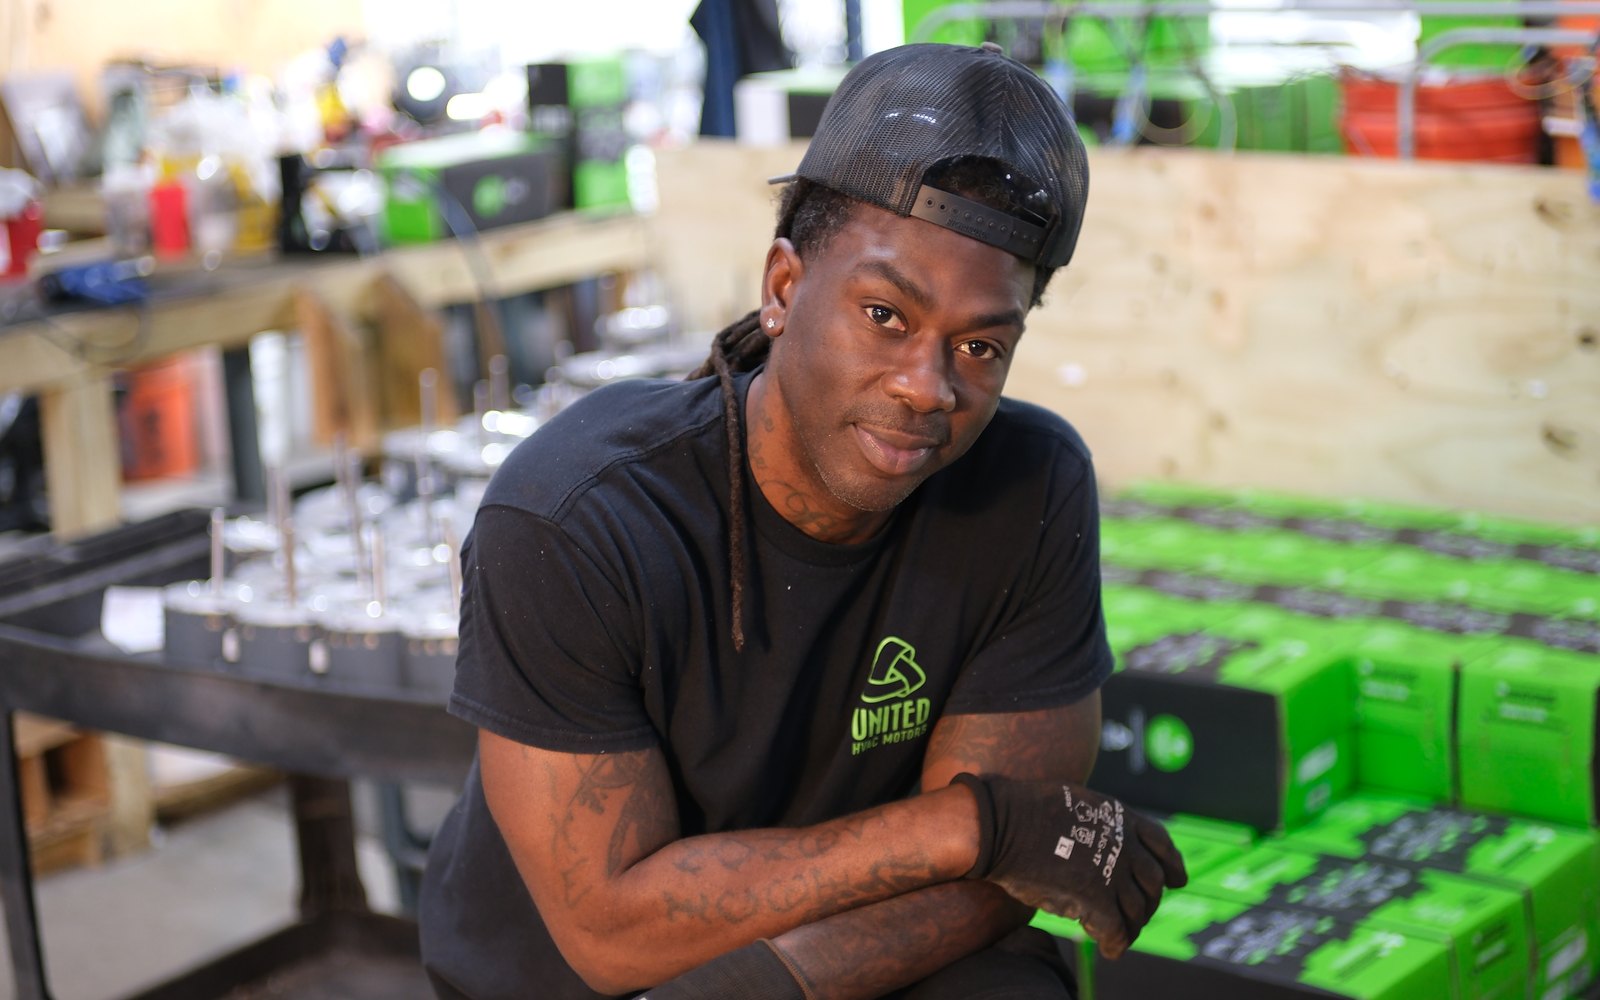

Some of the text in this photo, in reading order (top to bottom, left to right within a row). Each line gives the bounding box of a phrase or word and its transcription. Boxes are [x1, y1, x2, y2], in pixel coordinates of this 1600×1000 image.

[852, 698, 930, 740] UNITED
[883, 724, 928, 745] MOTORS
[1093, 825, 1112, 867] PUG-17
